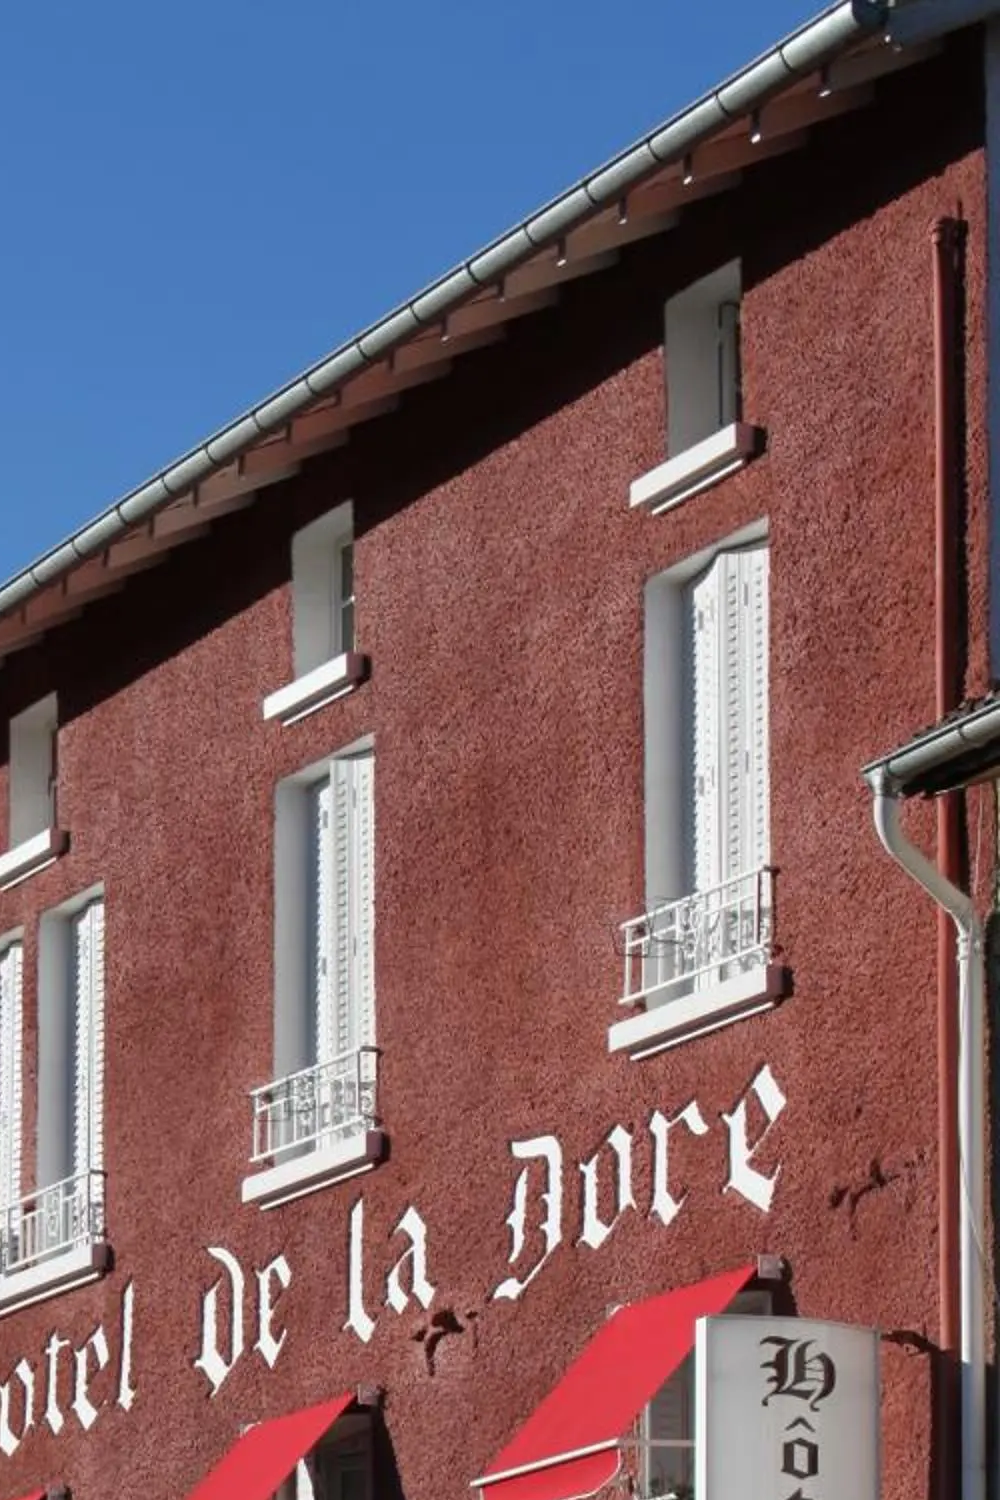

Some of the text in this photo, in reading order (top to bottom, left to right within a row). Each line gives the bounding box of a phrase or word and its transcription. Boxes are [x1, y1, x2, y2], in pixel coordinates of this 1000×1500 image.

[194, 1247, 292, 1398] de
[343, 1199, 436, 1343] la
[493, 1064, 787, 1300] Dore
